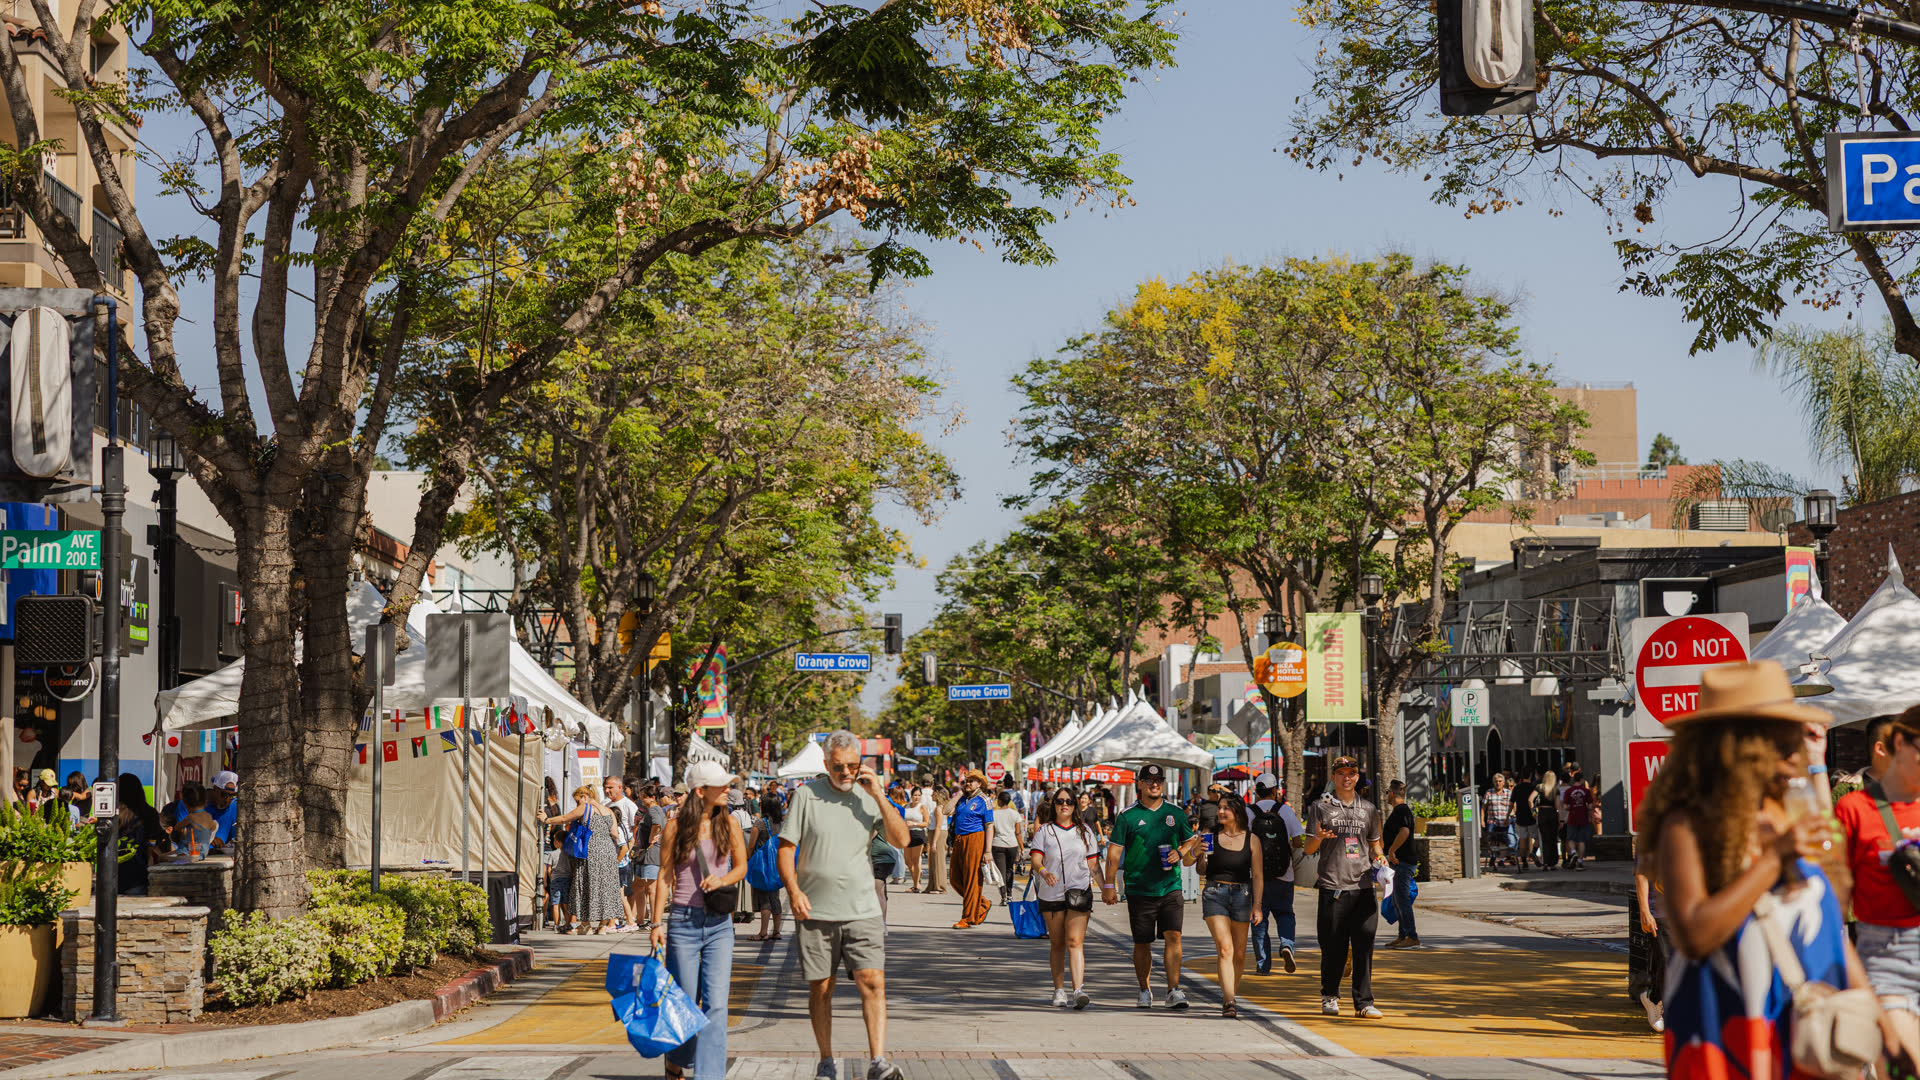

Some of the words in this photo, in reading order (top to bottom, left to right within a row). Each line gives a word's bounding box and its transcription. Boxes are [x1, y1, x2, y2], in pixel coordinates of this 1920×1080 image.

[1862, 154, 1920, 205] Pa
[71, 534, 94, 548] AVE
[2, 536, 61, 563] Palm
[66, 551, 87, 566] 200
[91, 552, 97, 566] E
[1651, 640, 1677, 660] DO
[1692, 638, 1730, 658] NOT
[798, 656, 835, 669] Orange
[838, 656, 867, 668] Grove
[1323, 628, 1344, 707] WELCOME
[951, 688, 981, 698] Orange
[984, 686, 1008, 697] Grove
[1661, 692, 1699, 712] ENT
[1464, 708, 1477, 716] PAY
[1460, 716, 1480, 724] HERE
[1053, 770, 1088, 781] FIRST
[1089, 772, 1109, 782] AID
